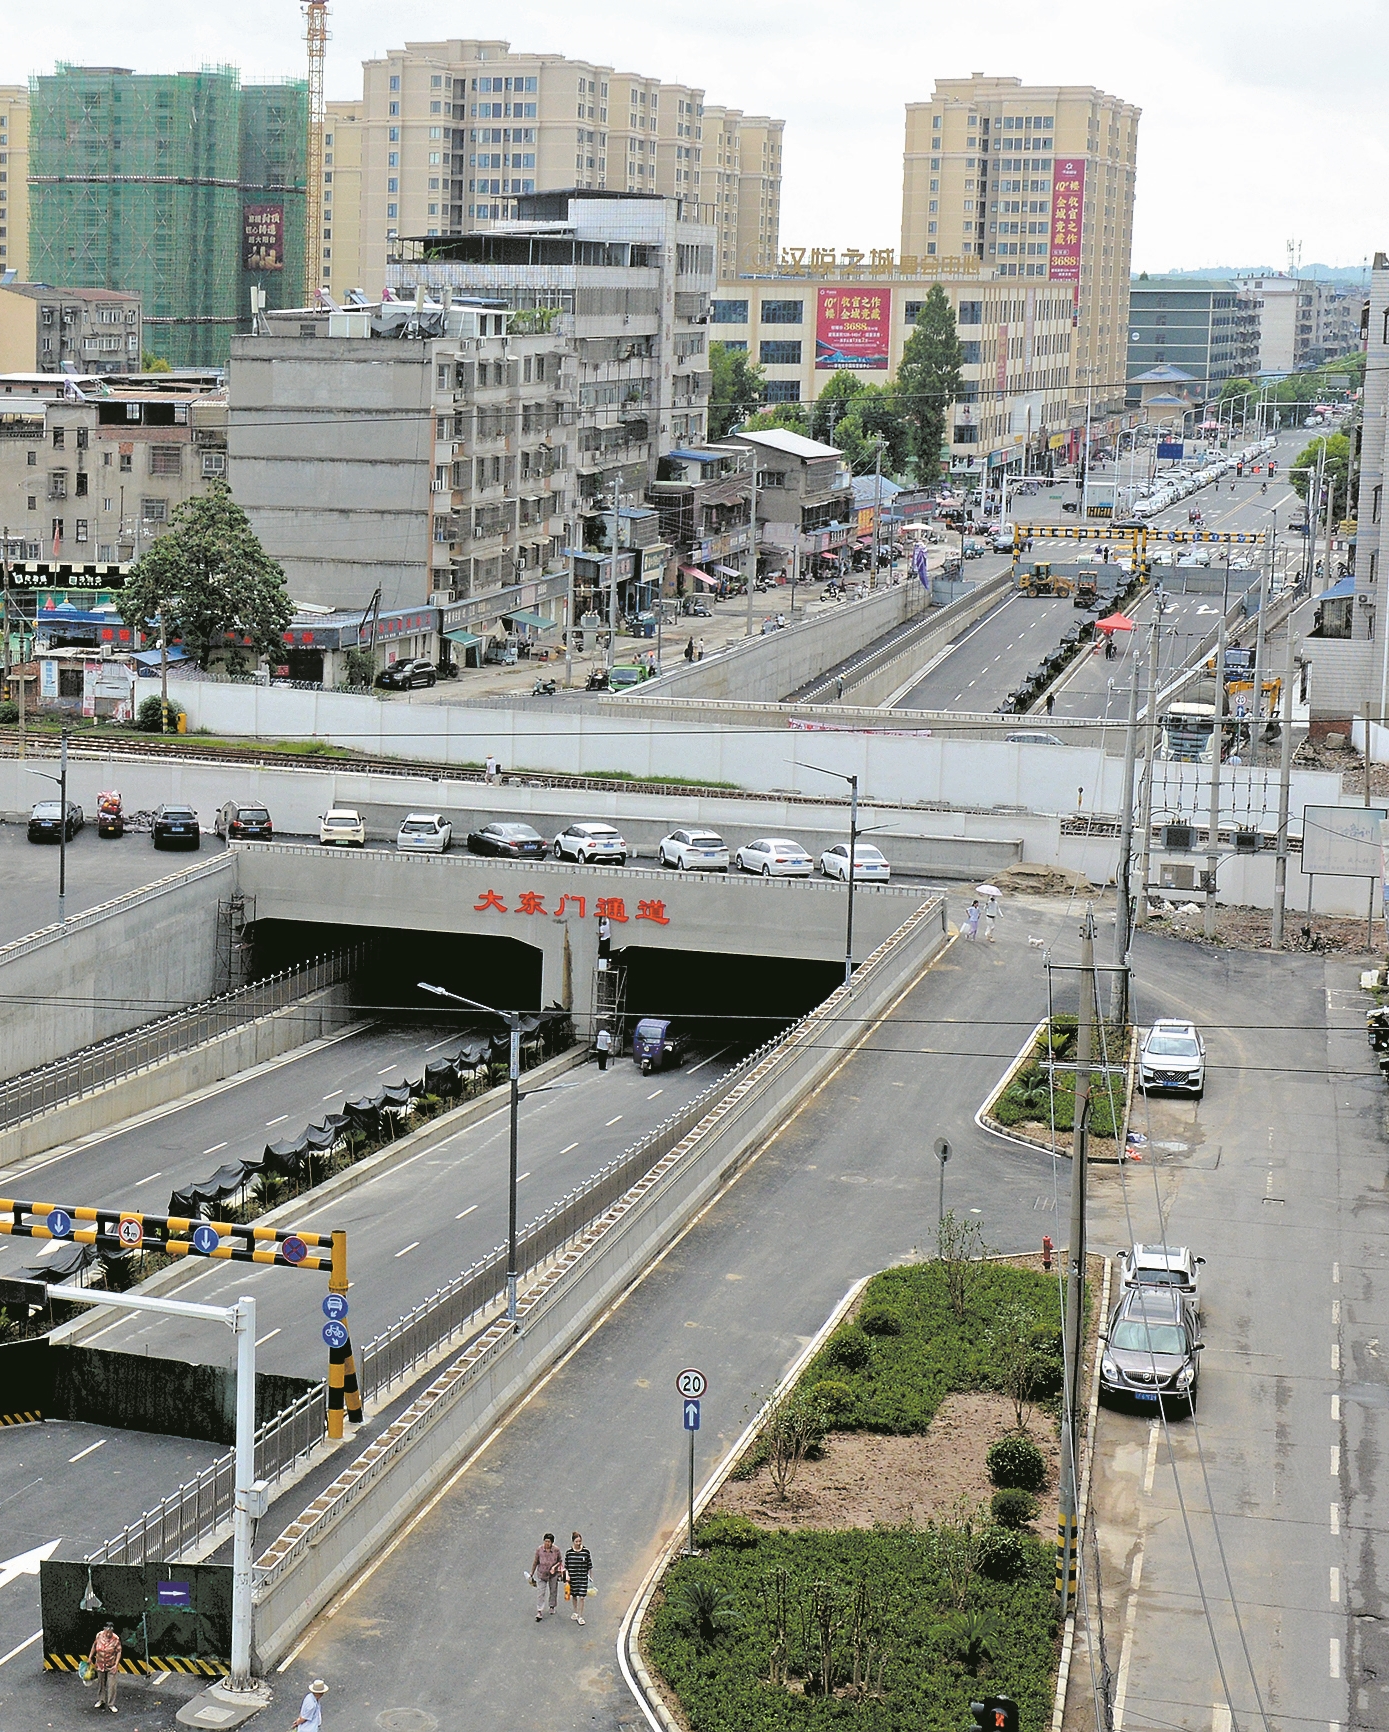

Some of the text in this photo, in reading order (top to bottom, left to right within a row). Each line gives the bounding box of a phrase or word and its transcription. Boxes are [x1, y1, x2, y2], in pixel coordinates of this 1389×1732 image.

[844, 322, 868, 330] 3688
[474, 889, 670, 925] 大东门通道
[122, 1224, 138, 1238] 4m
[683, 1376, 700, 1392] 20
